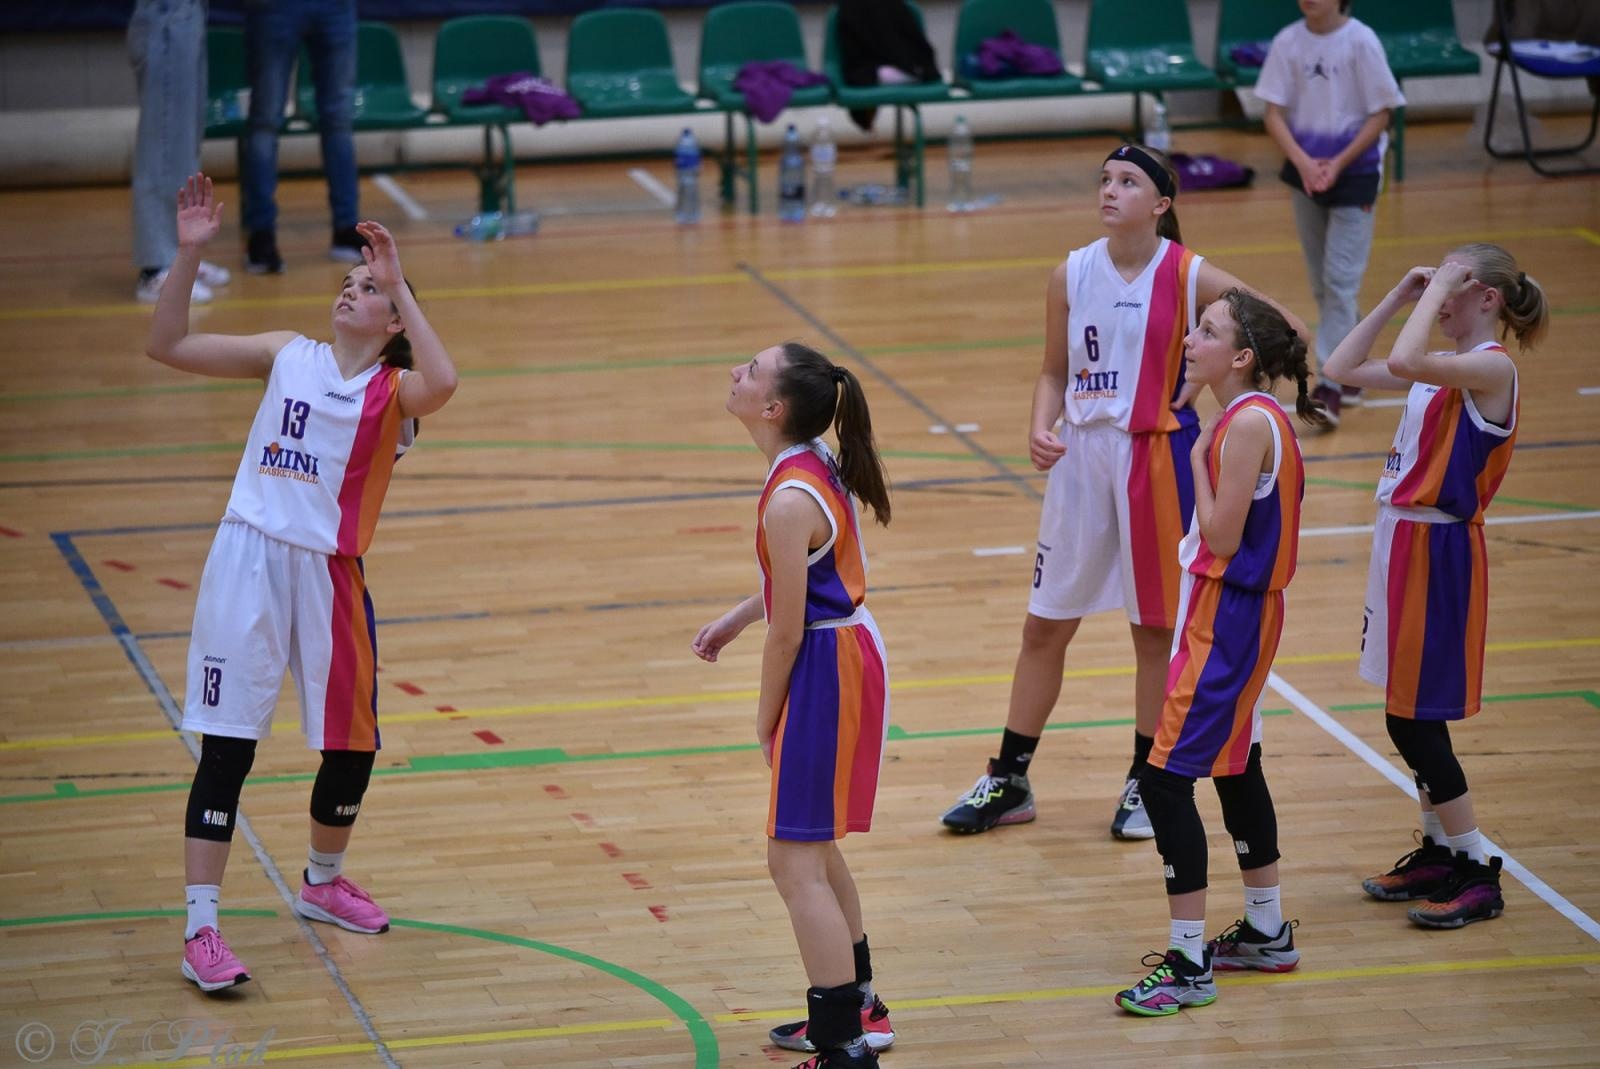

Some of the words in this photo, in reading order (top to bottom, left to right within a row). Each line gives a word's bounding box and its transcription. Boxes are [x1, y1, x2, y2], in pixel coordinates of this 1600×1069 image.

[1084, 325, 1099, 362] 6
[1075, 371, 1119, 391] MINI
[280, 398, 310, 440] 13
[258, 466, 318, 484] BASKETBALL
[260, 445, 319, 477] MINI
[1033, 551, 1044, 590] 6
[203, 666, 222, 707] 13
[211, 810, 228, 826] NBA
